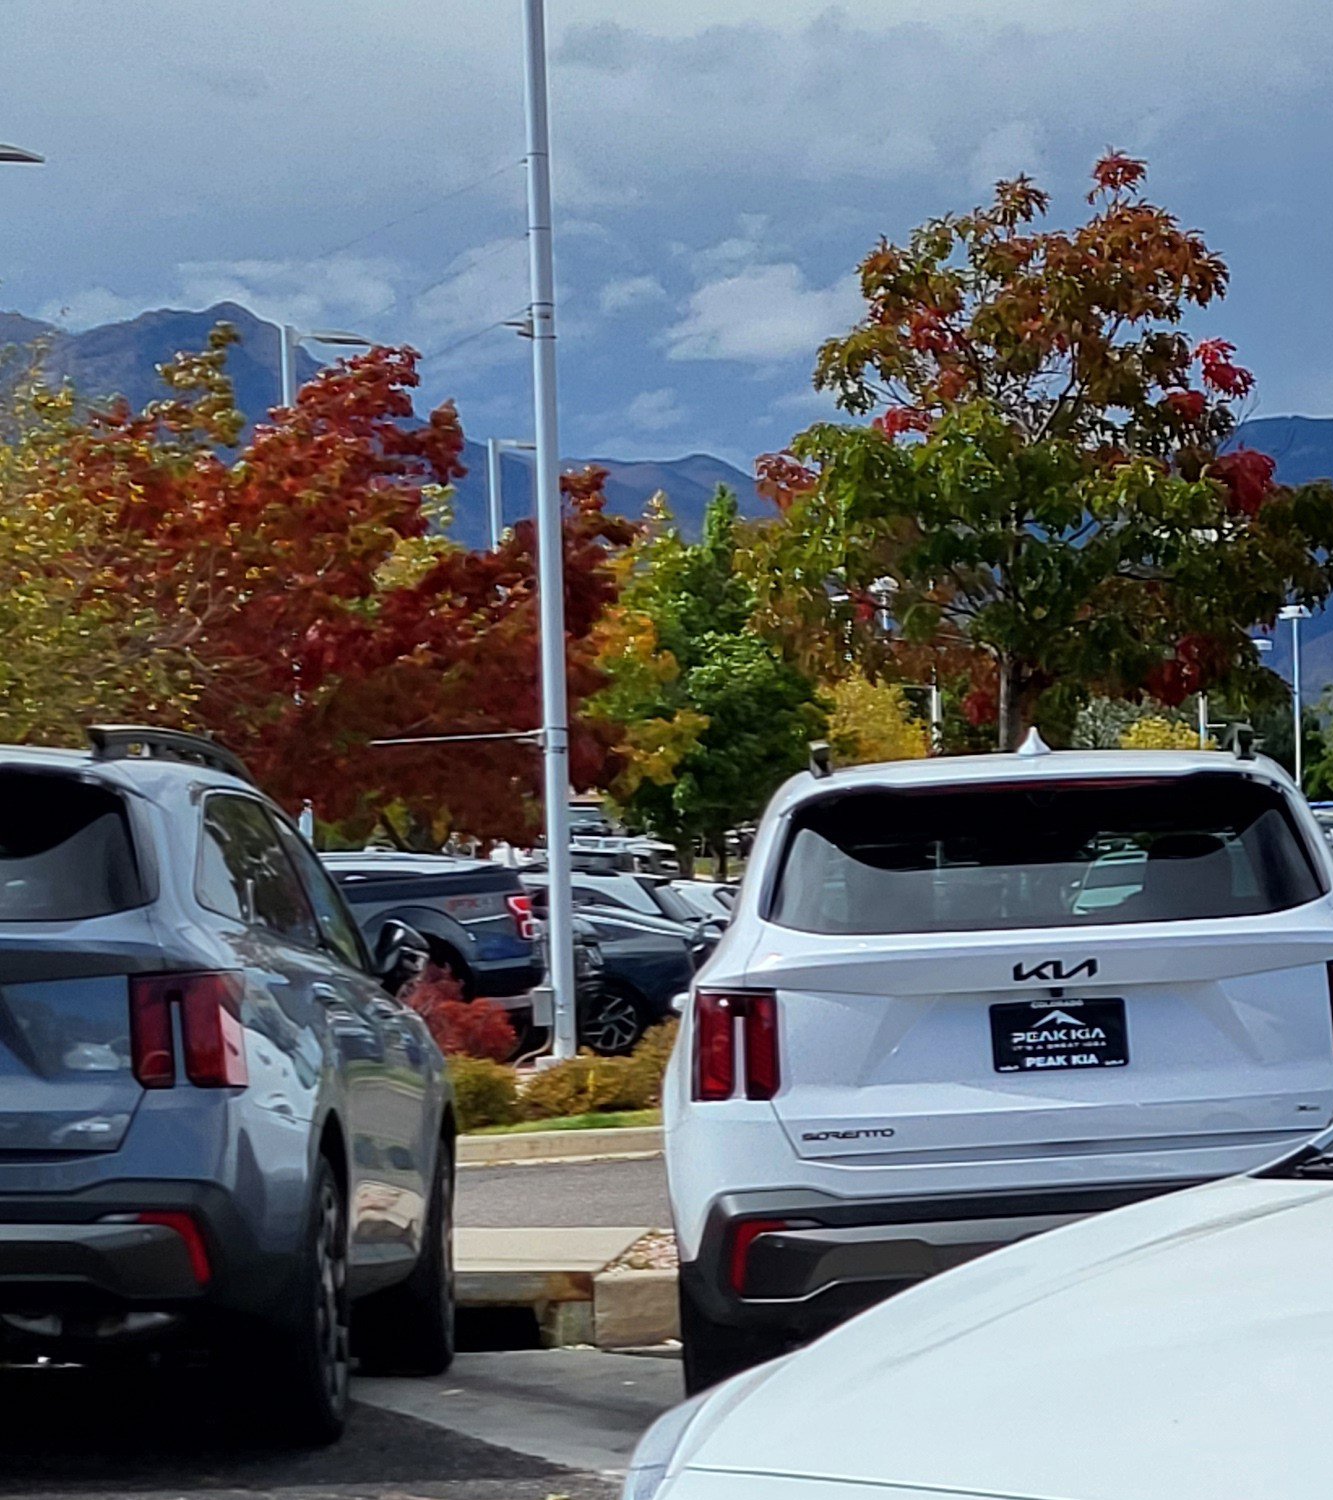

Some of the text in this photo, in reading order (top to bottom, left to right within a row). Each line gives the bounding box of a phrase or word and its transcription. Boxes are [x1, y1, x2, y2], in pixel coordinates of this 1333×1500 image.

[1012, 958, 1098, 981] KIA
[1011, 1030, 1068, 1043] PEAK
[1024, 1055, 1068, 1067] PEAK
[1071, 1053, 1099, 1065] KIA
[802, 1128, 895, 1141] SORENTO
